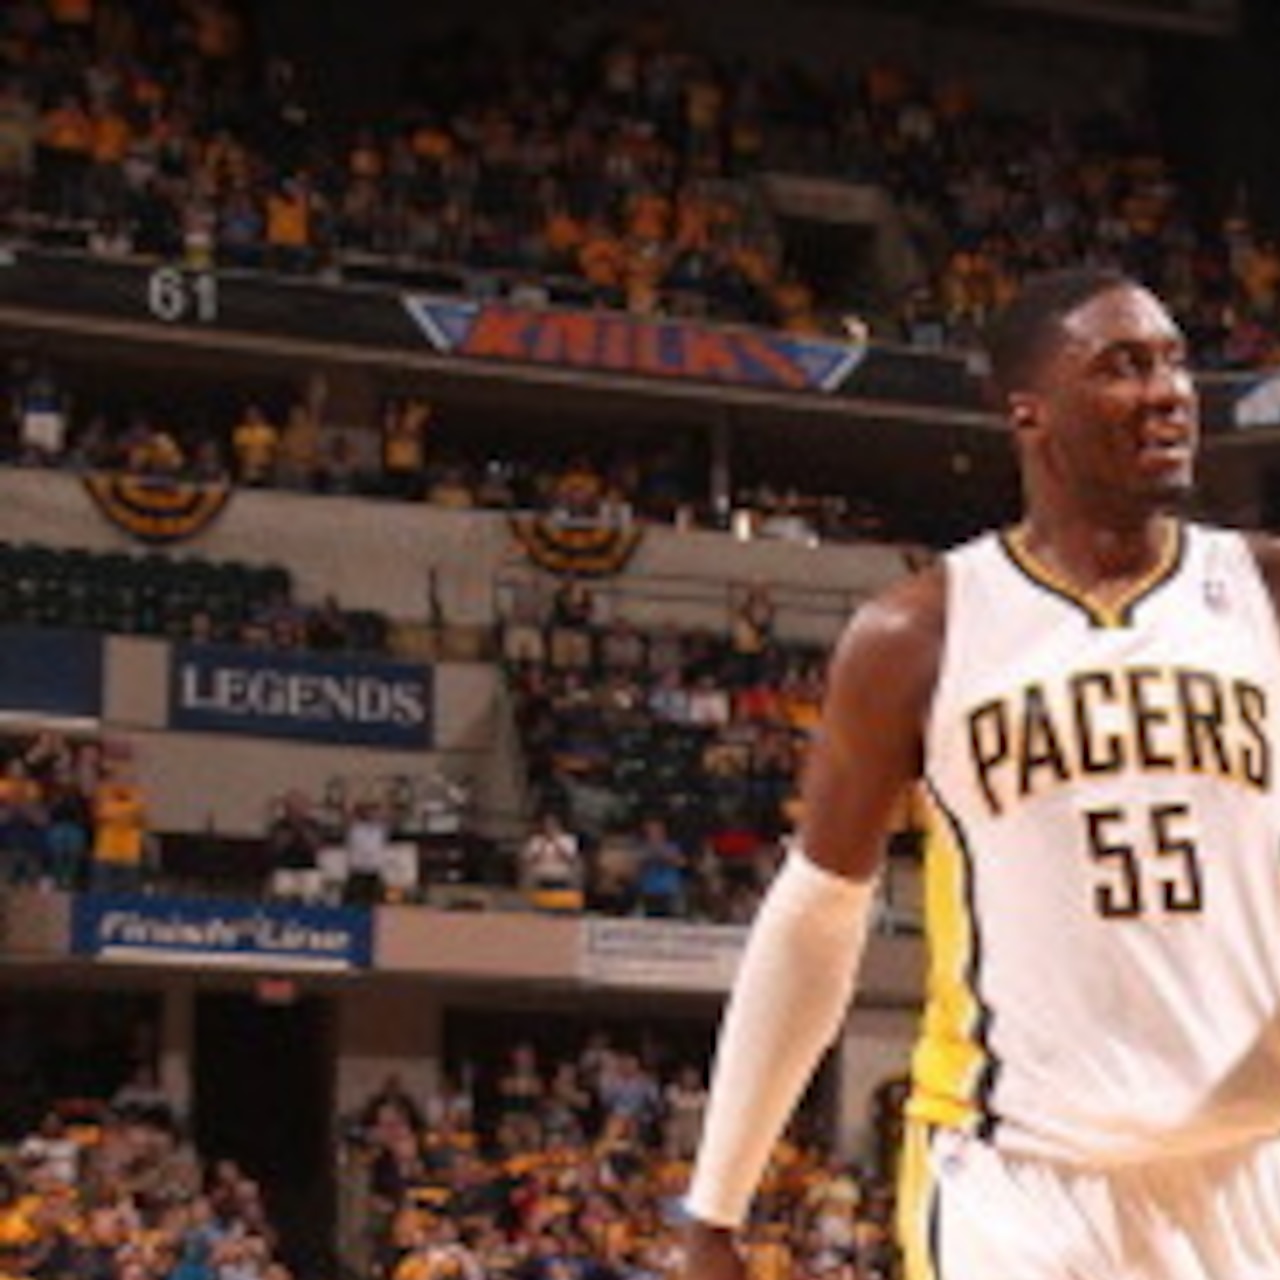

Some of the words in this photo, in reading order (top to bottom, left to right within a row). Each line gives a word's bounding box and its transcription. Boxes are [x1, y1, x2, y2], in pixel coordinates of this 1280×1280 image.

[148, 269, 217, 321] 61
[180, 662, 426, 727] LEGENDS
[966, 665, 1276, 816] PACERS
[1081, 803, 1205, 919] 55
[256, 915, 352, 951] Line
